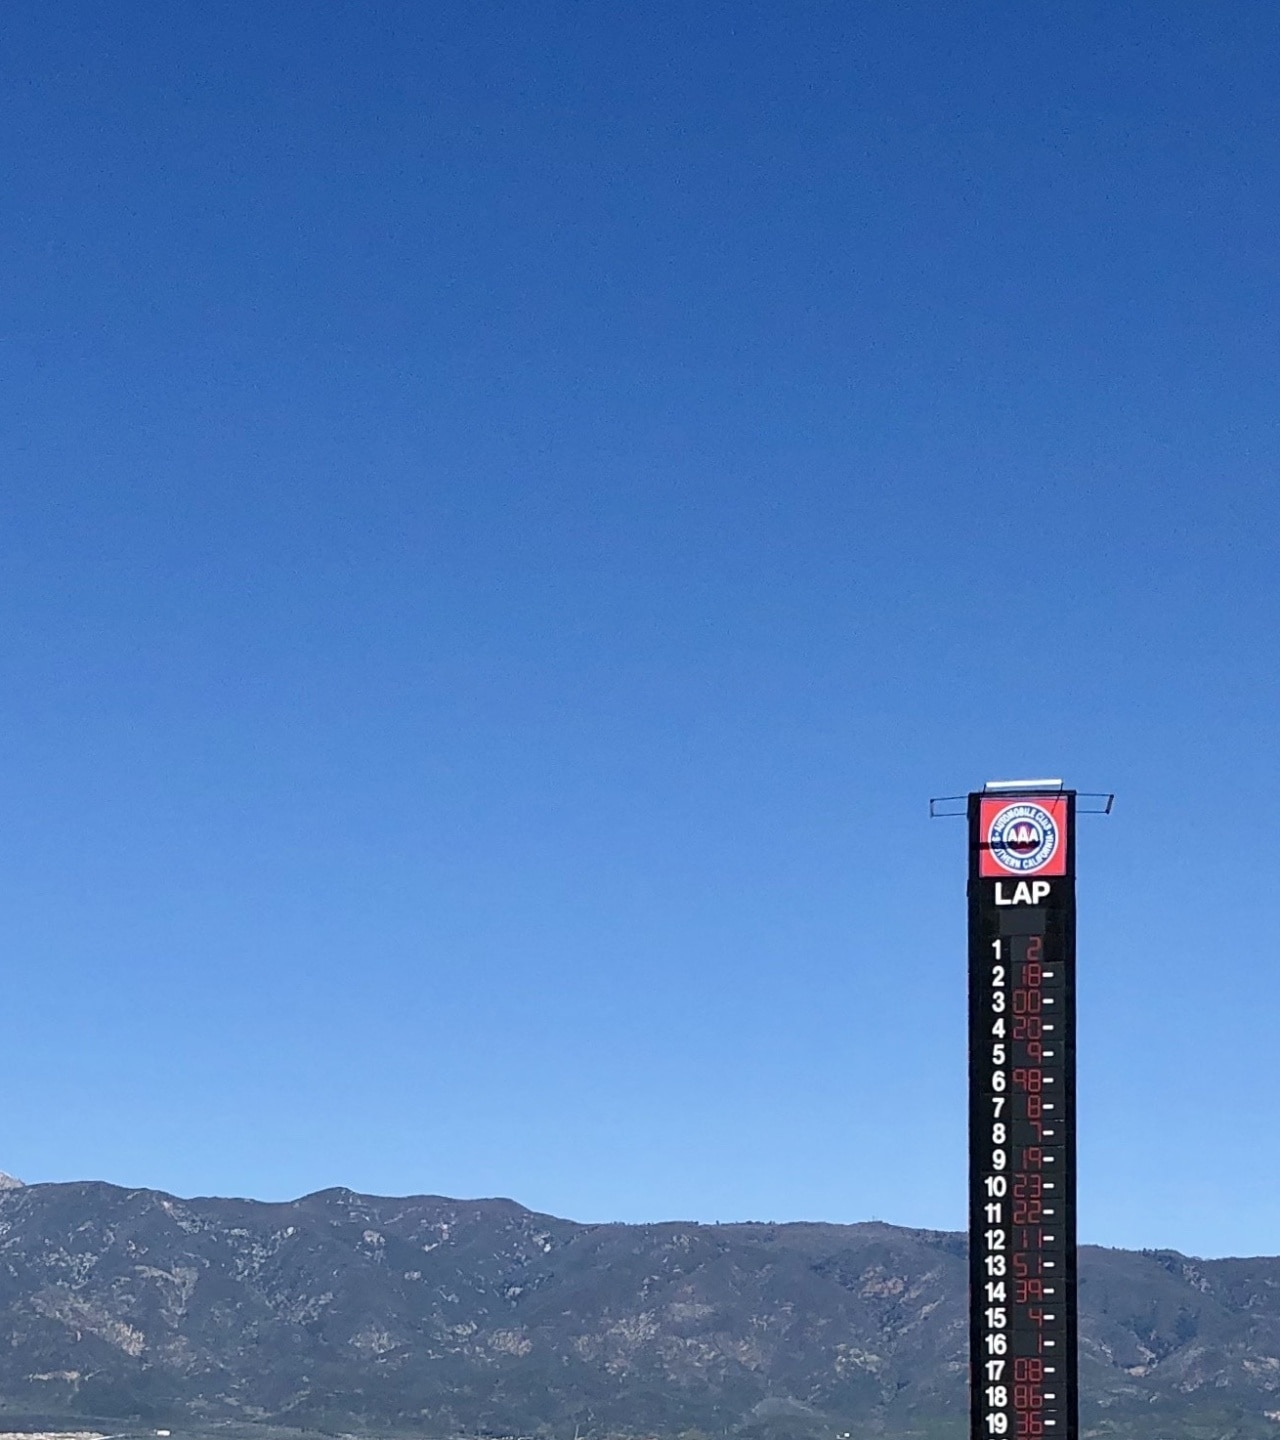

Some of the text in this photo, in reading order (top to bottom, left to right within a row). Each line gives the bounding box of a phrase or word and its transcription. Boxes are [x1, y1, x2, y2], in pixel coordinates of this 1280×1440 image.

[1007, 826, 1039, 844] AAA
[995, 881, 1051, 905] LAP
[992, 940, 1001, 959] 1
[993, 966, 1005, 986] 2
[992, 991, 1006, 1012] 3
[992, 1018, 1006, 1038] 4
[993, 1044, 1006, 1064] 5
[993, 1071, 1006, 1091] 6
[992, 1098, 1005, 1117] 7
[993, 1123, 1006, 1144] 8
[993, 1149, 1006, 1170] 9
[984, 1176, 1007, 1197] 10
[984, 1203, 1002, 1223] 11
[984, 1230, 1006, 1250] 12
[984, 1255, 1007, 1276] 13
[984, 1282, 1007, 1302] 14
[984, 1308, 1007, 1328] 15
[984, 1334, 1007, 1354] 16
[984, 1360, 1007, 1380] 17
[985, 1386, 1009, 1407] 18
[985, 1413, 1009, 1433] 19
